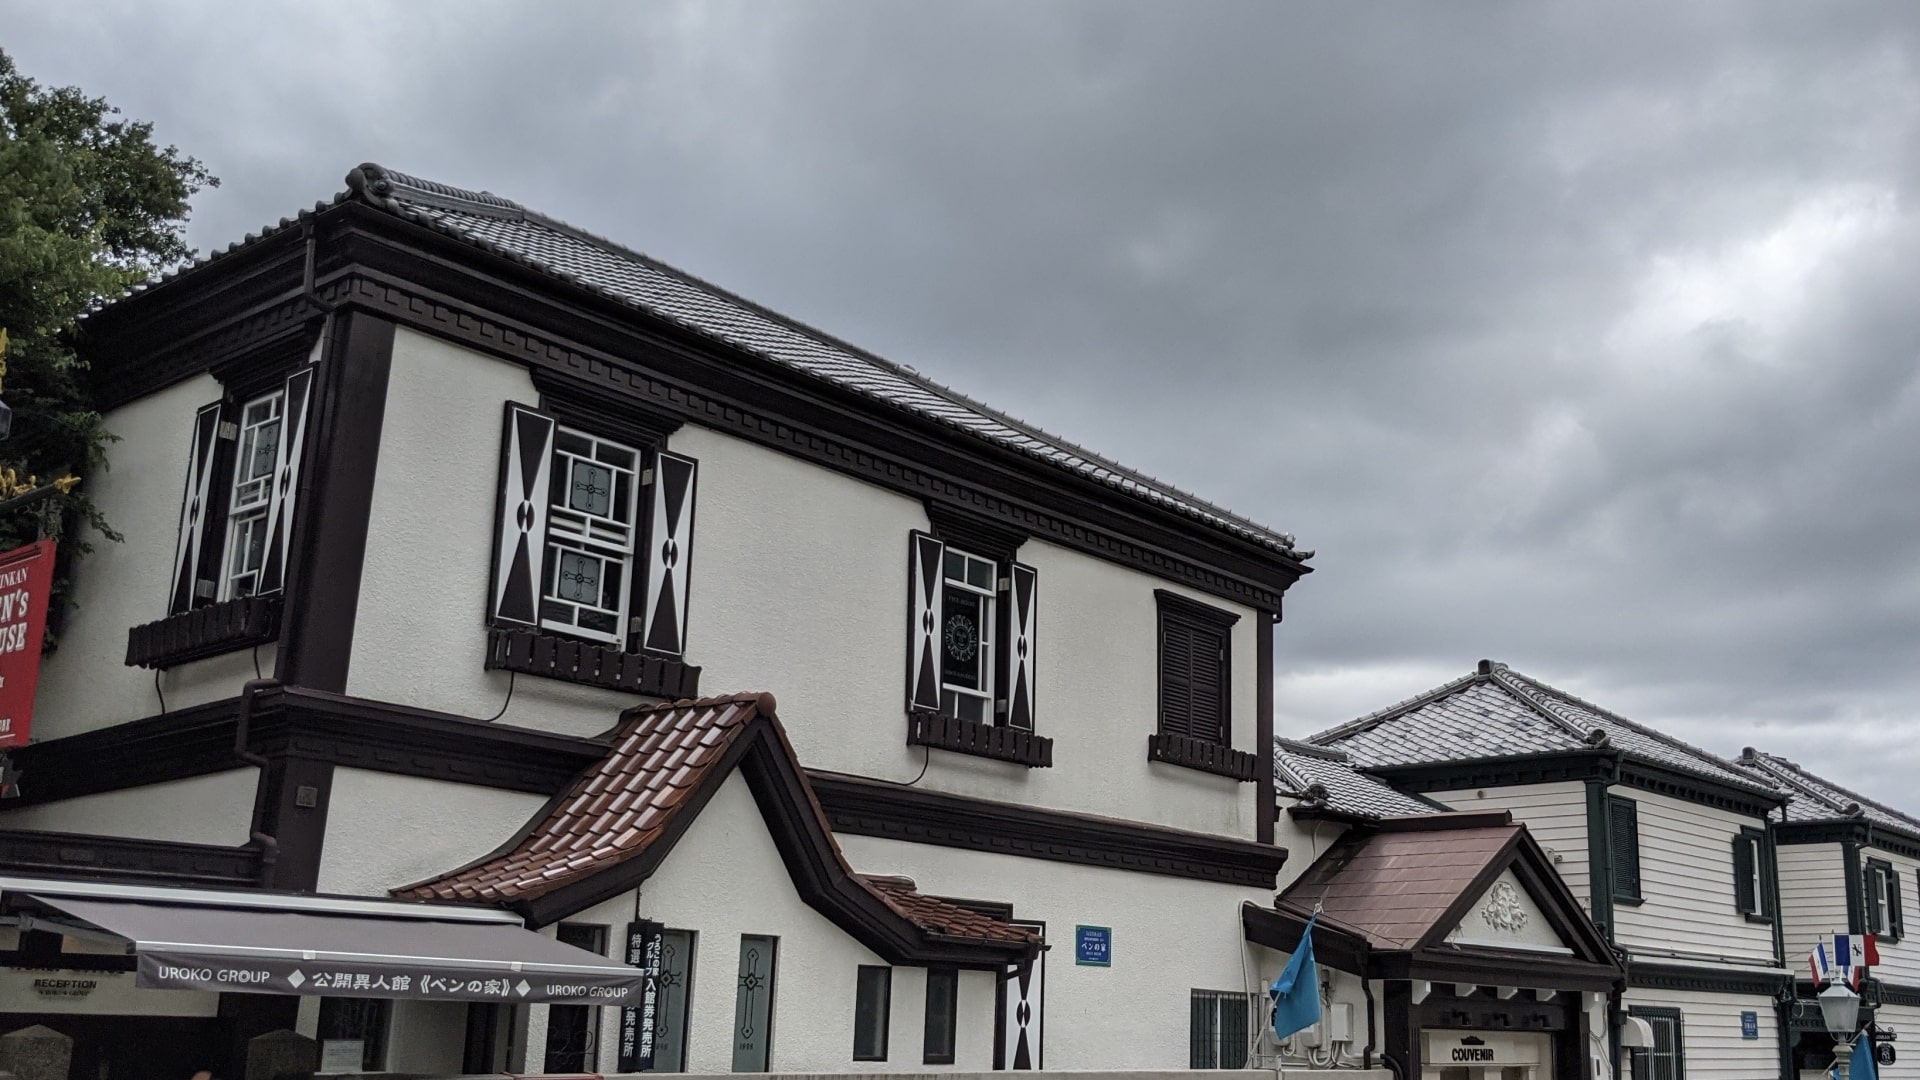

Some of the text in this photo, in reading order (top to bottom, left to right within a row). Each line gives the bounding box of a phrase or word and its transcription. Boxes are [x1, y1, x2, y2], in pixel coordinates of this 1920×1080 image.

[34, 979, 97, 989] RECEPTION
[158, 966, 212, 981] UROKO
[217, 969, 271, 983] GROUP
[546, 984, 587, 996] UROKO
[589, 985, 629, 998] GROUP
[623, 1006, 637, 1058] 発売所
[1452, 1047, 1494, 1062] COUVENIR
